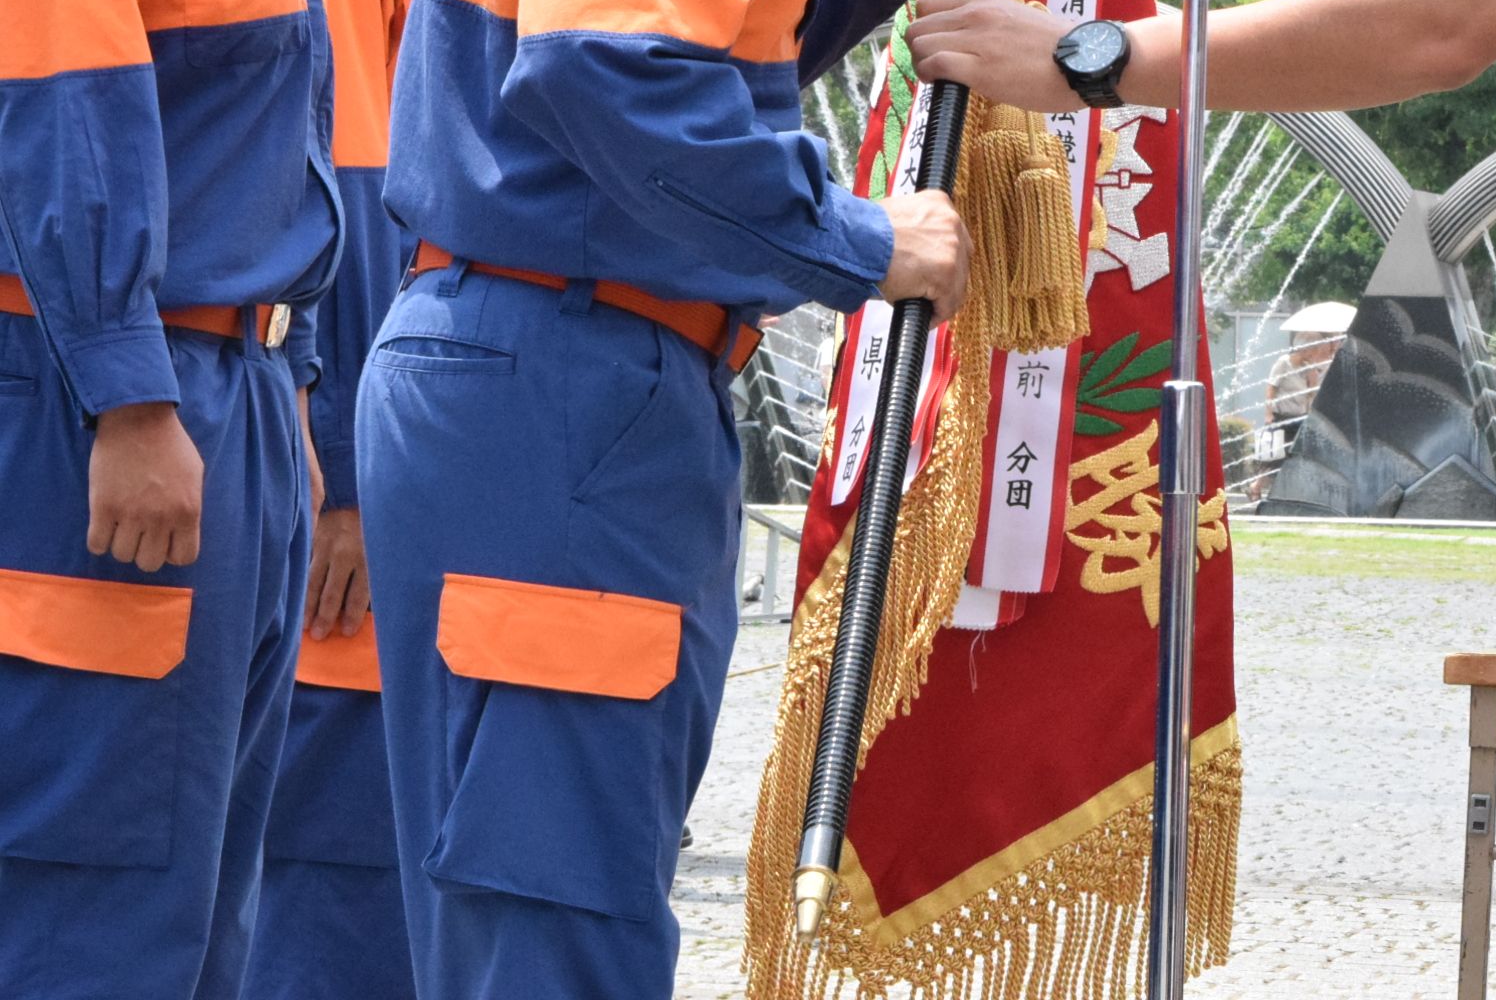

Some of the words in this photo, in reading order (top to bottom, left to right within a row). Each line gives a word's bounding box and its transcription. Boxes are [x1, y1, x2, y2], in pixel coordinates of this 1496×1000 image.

[1016, 361, 1050, 400] 前
[842, 415, 866, 481] 分団
[1005, 441, 1038, 511] 分団
